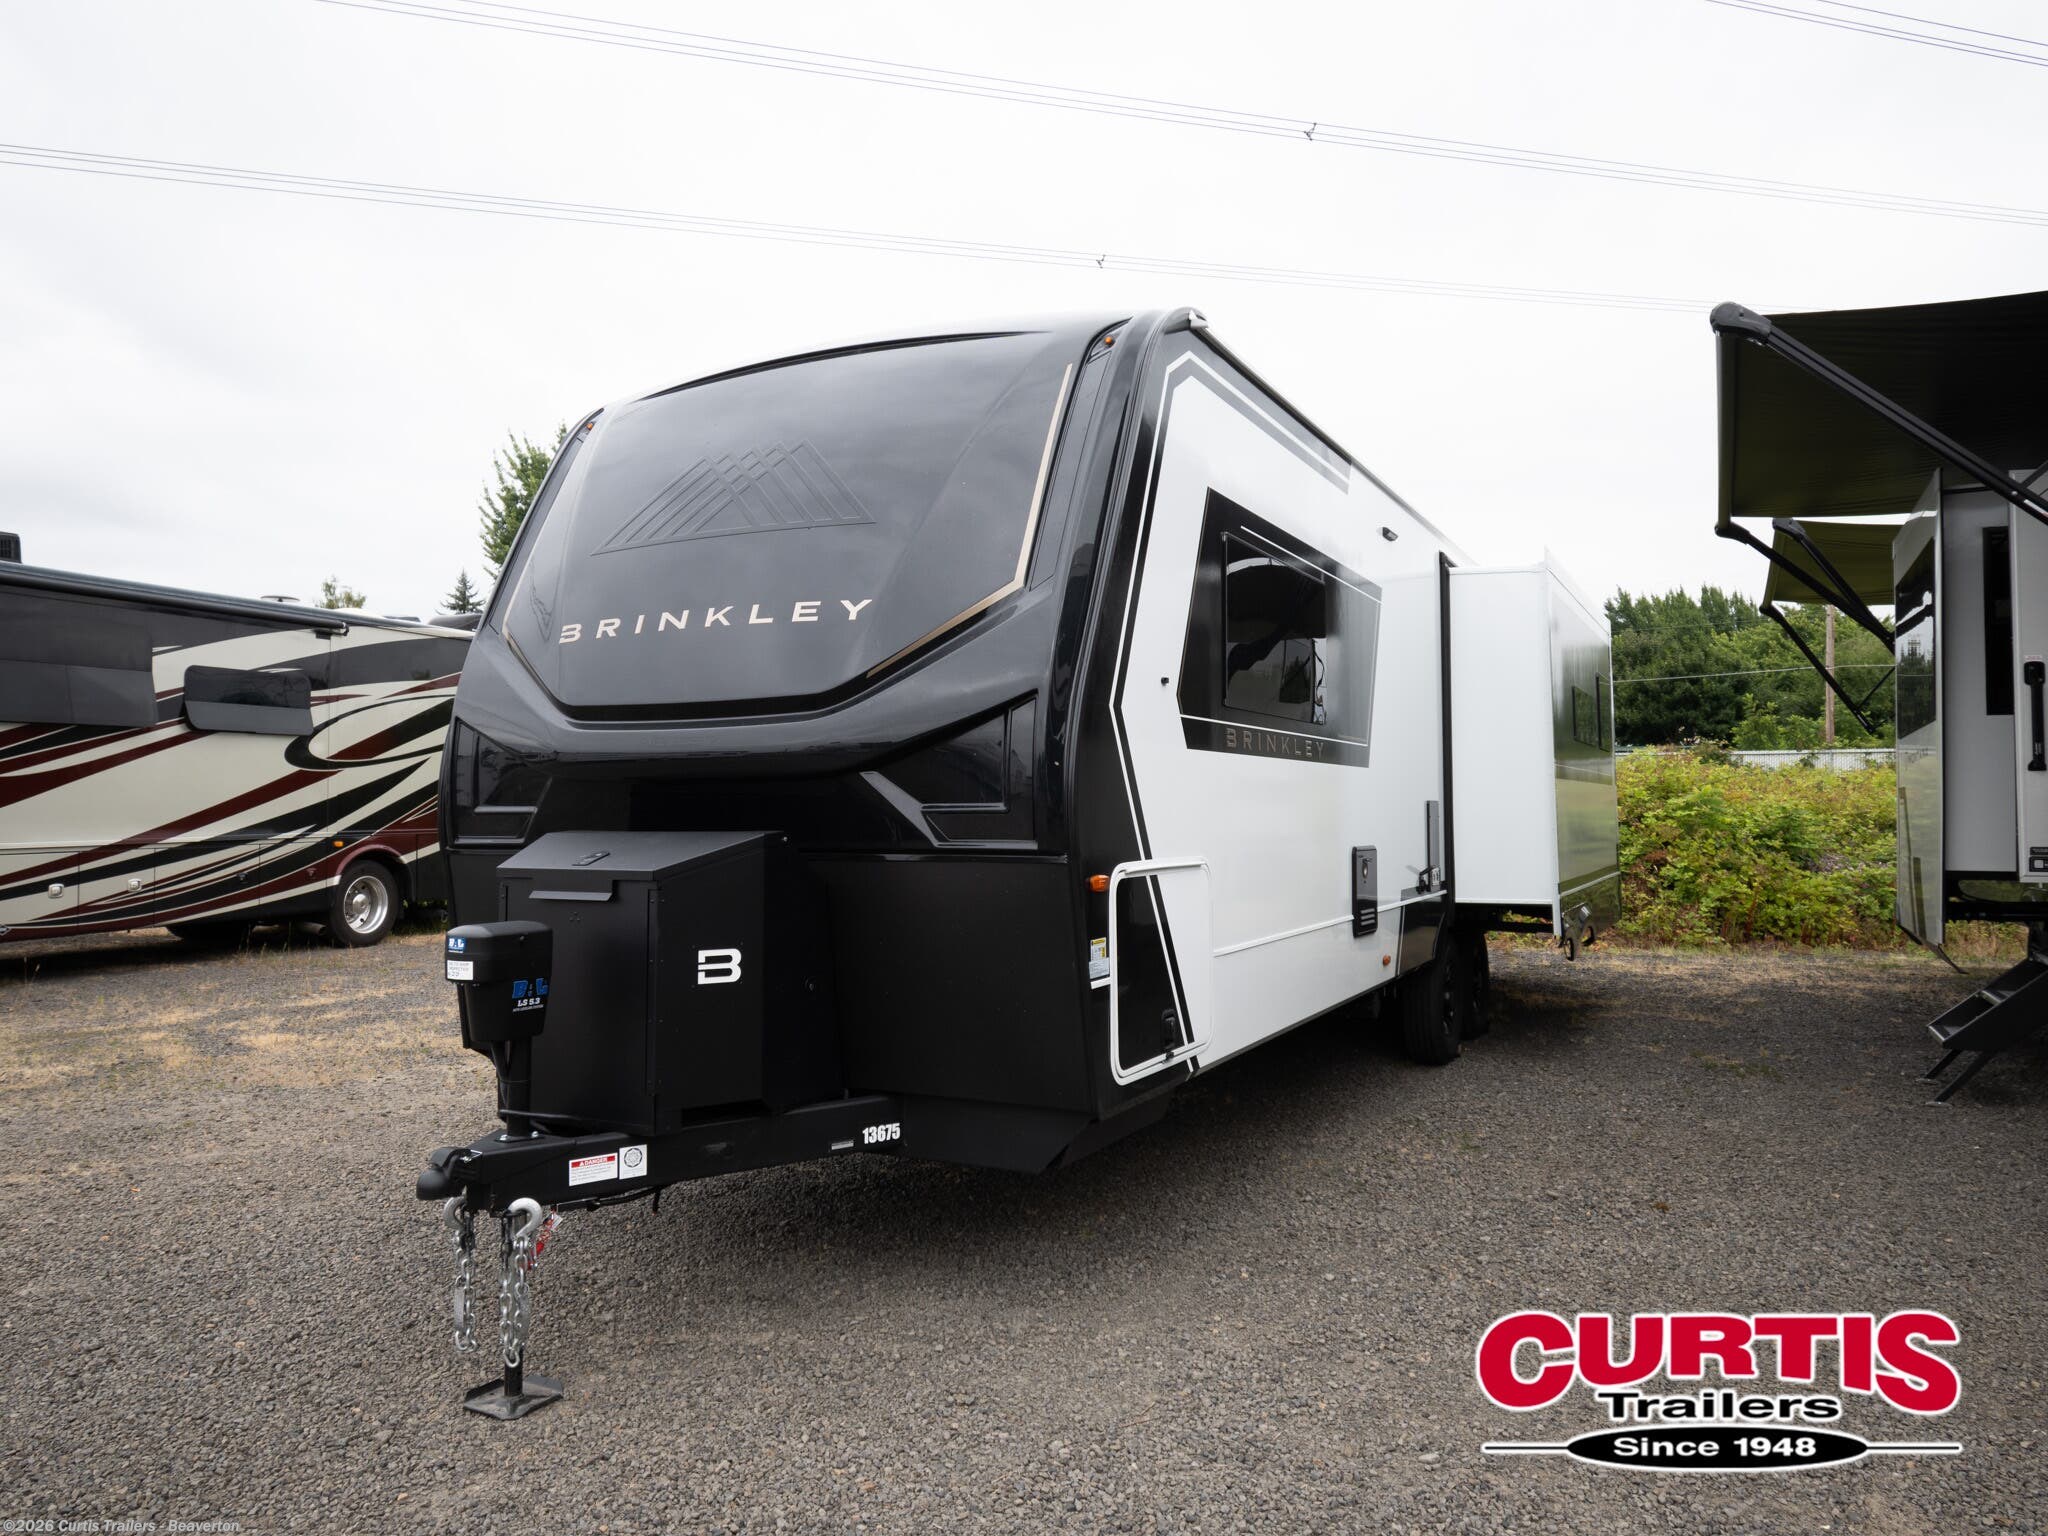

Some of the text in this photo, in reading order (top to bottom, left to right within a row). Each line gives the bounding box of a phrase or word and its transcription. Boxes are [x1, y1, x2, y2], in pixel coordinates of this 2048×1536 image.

[559, 599, 873, 644] BRINKLEY
[1225, 727, 1325, 759] BRINKLEY
[697, 948, 742, 985] B
[862, 1122, 901, 1145] 13675
